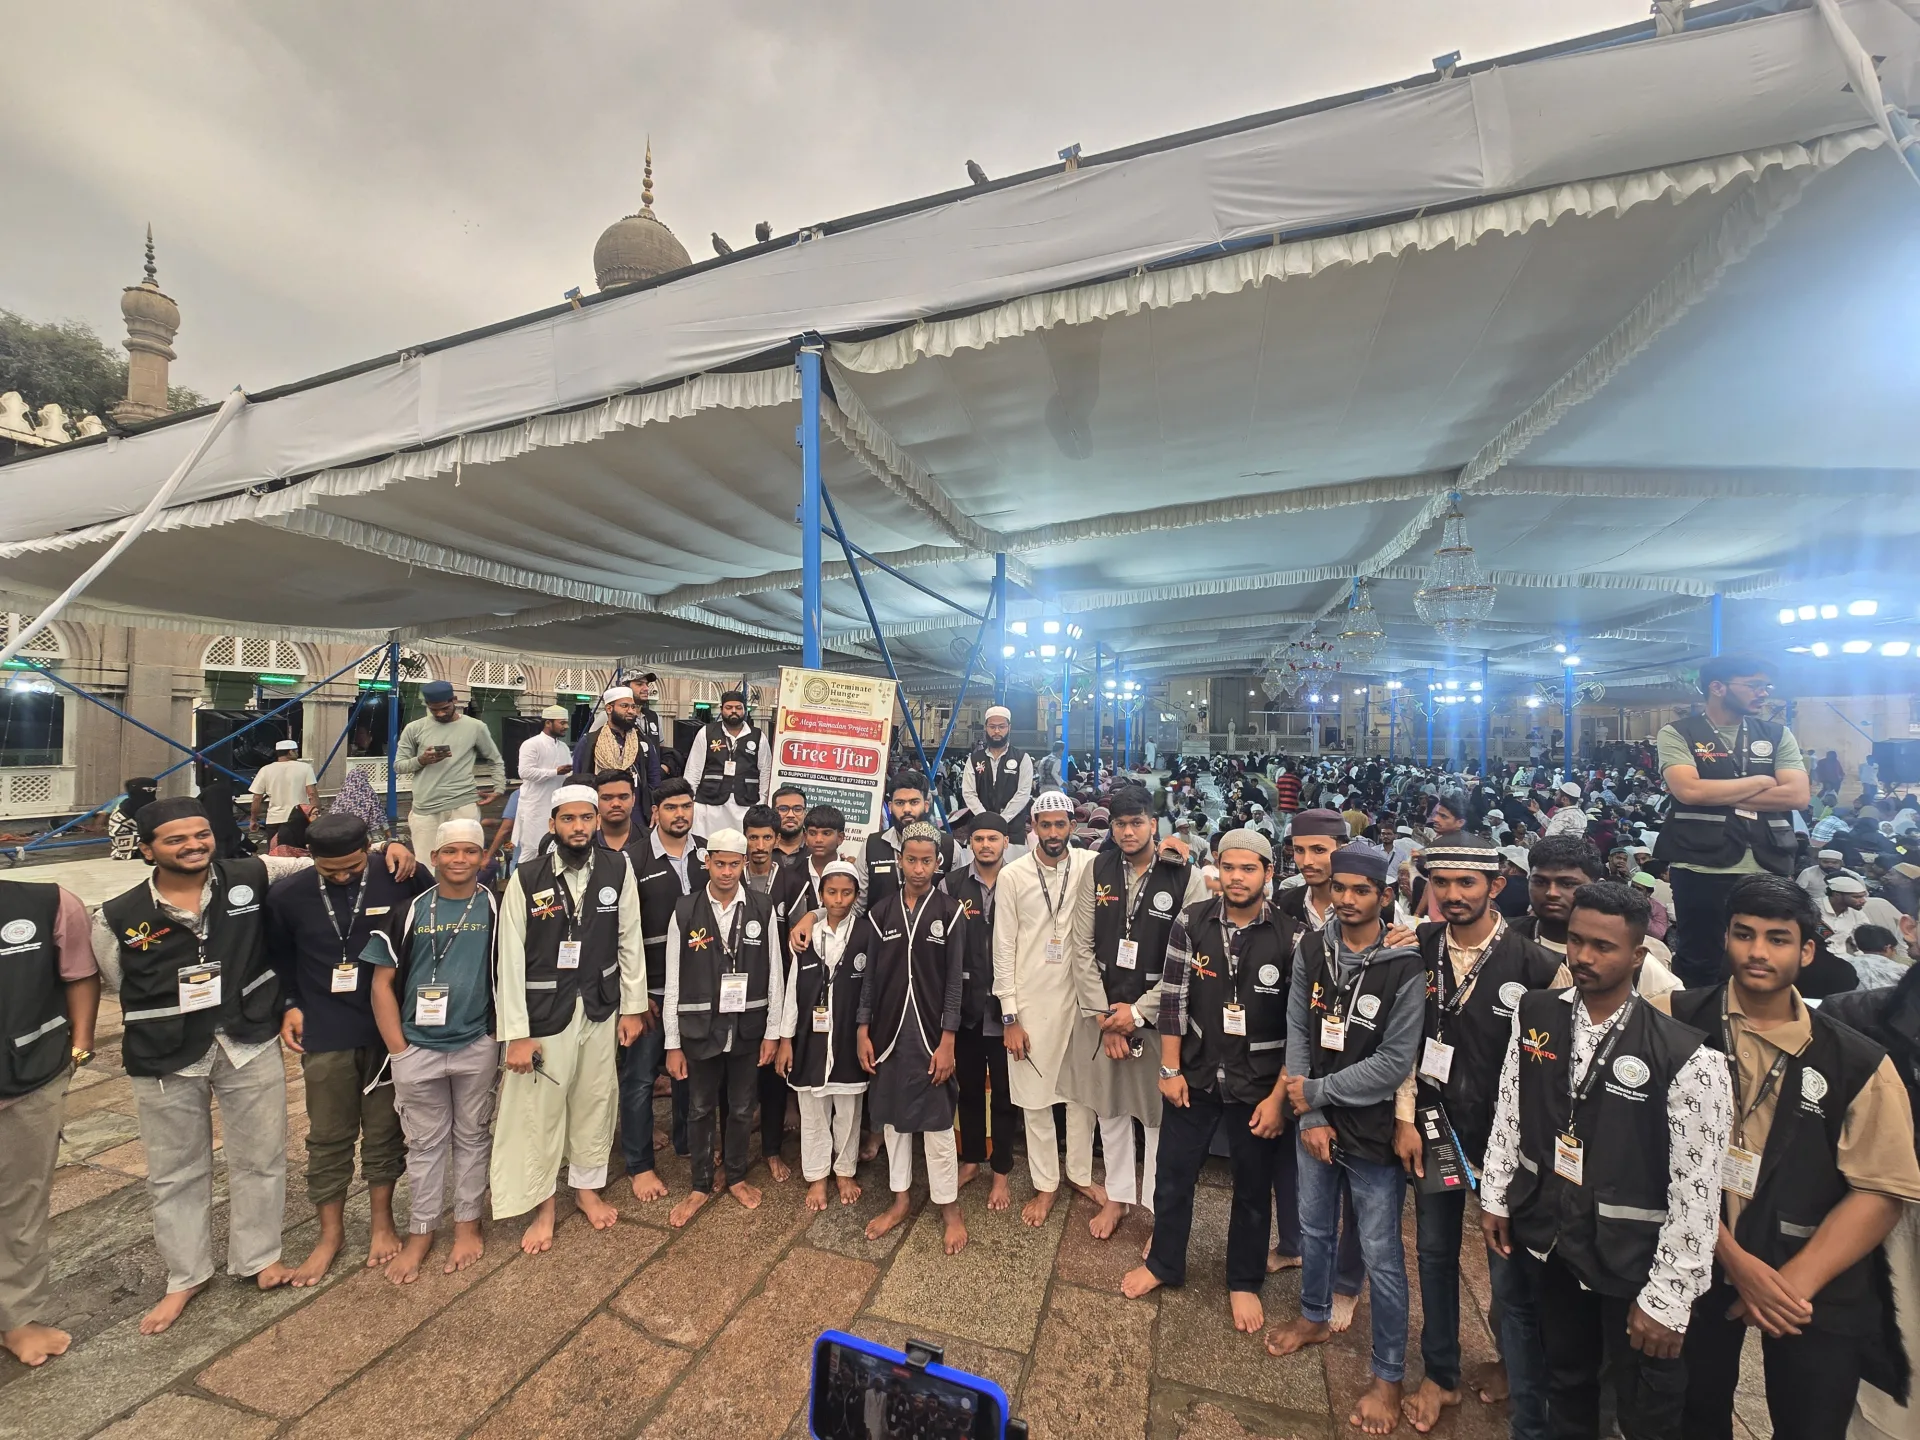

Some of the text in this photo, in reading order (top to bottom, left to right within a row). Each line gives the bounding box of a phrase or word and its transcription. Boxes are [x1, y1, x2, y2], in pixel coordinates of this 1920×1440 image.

[831, 682, 872, 693] Terminate
[830, 689, 860, 699] Hunger
[800, 719, 817, 728] Mega
[818, 720, 847, 730] Ramadan
[847, 723, 869, 734] Project
[789, 742, 873, 770] Free Iftar
[788, 771, 810, 779] SUPPORT
[816, 787, 837, 796] farmaya
[851, 807, 869, 815] sawab
